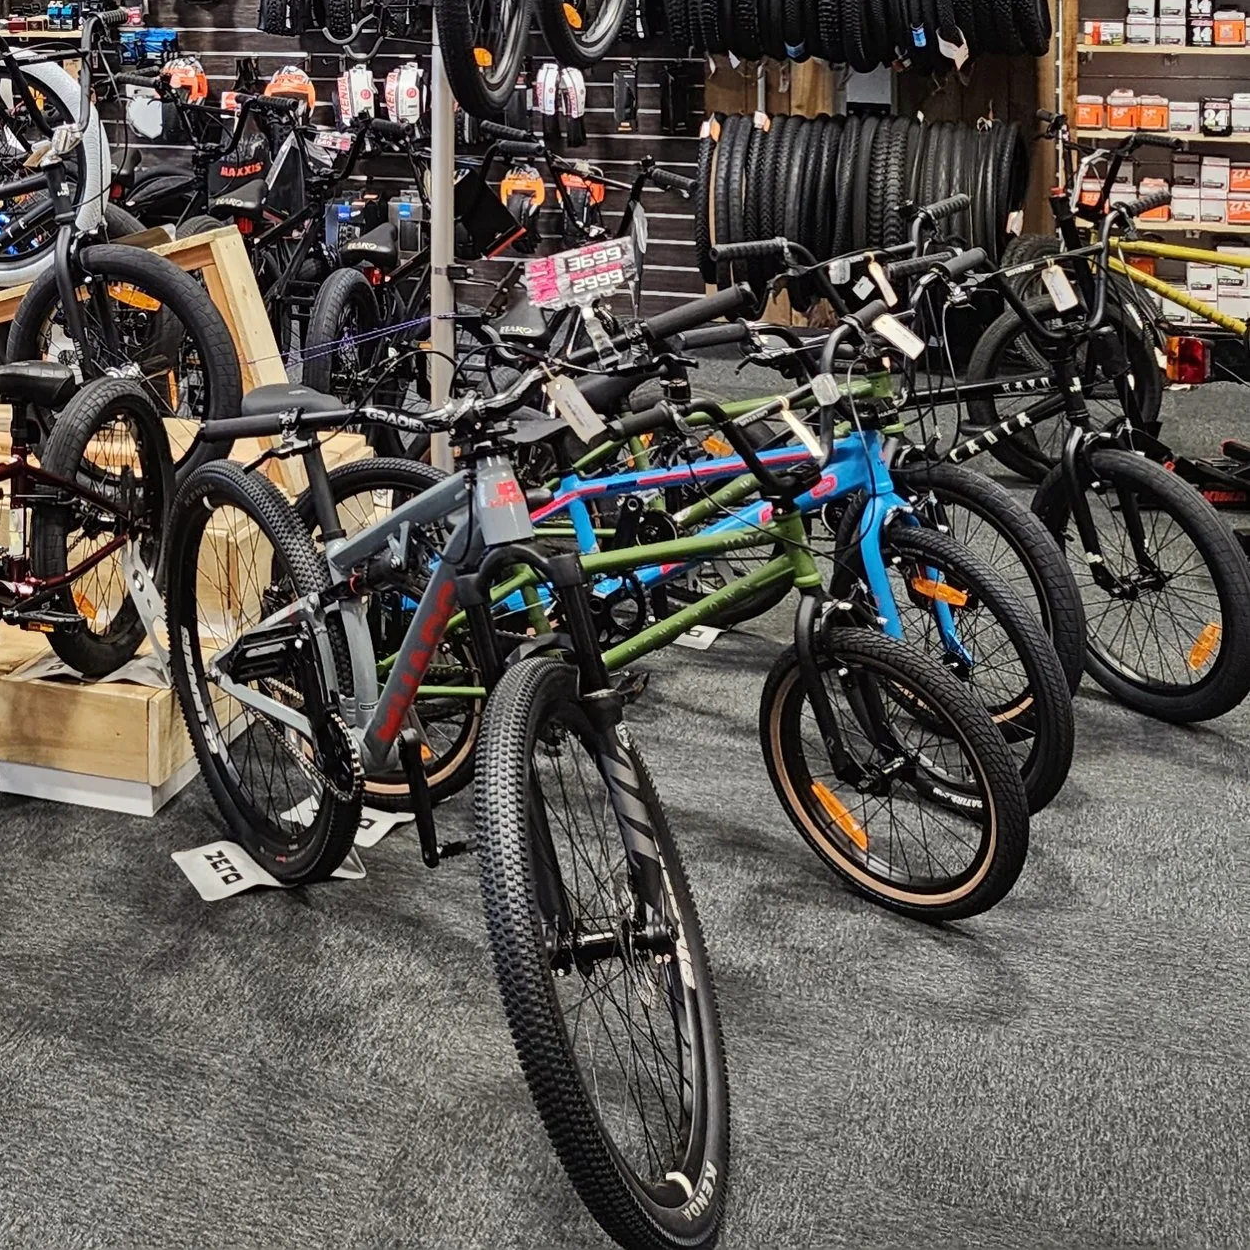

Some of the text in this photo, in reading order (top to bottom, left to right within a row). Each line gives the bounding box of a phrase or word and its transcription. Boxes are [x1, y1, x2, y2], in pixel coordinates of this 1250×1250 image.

[339, 75, 351, 118] KENDA
[386, 72, 398, 114] KENDA
[1203, 109, 1229, 126] 24
[220, 162, 262, 178] MAXXIS
[347, 241, 377, 250] HARO
[567, 245, 623, 272] 3699
[572, 268, 625, 294] 2999
[499, 325, 533, 334] HARO
[365, 407, 430, 432] GRADIEN
[950, 411, 1033, 465] CADIA
[203, 850, 244, 886] ZERO
[682, 1160, 718, 1222] KENDA
